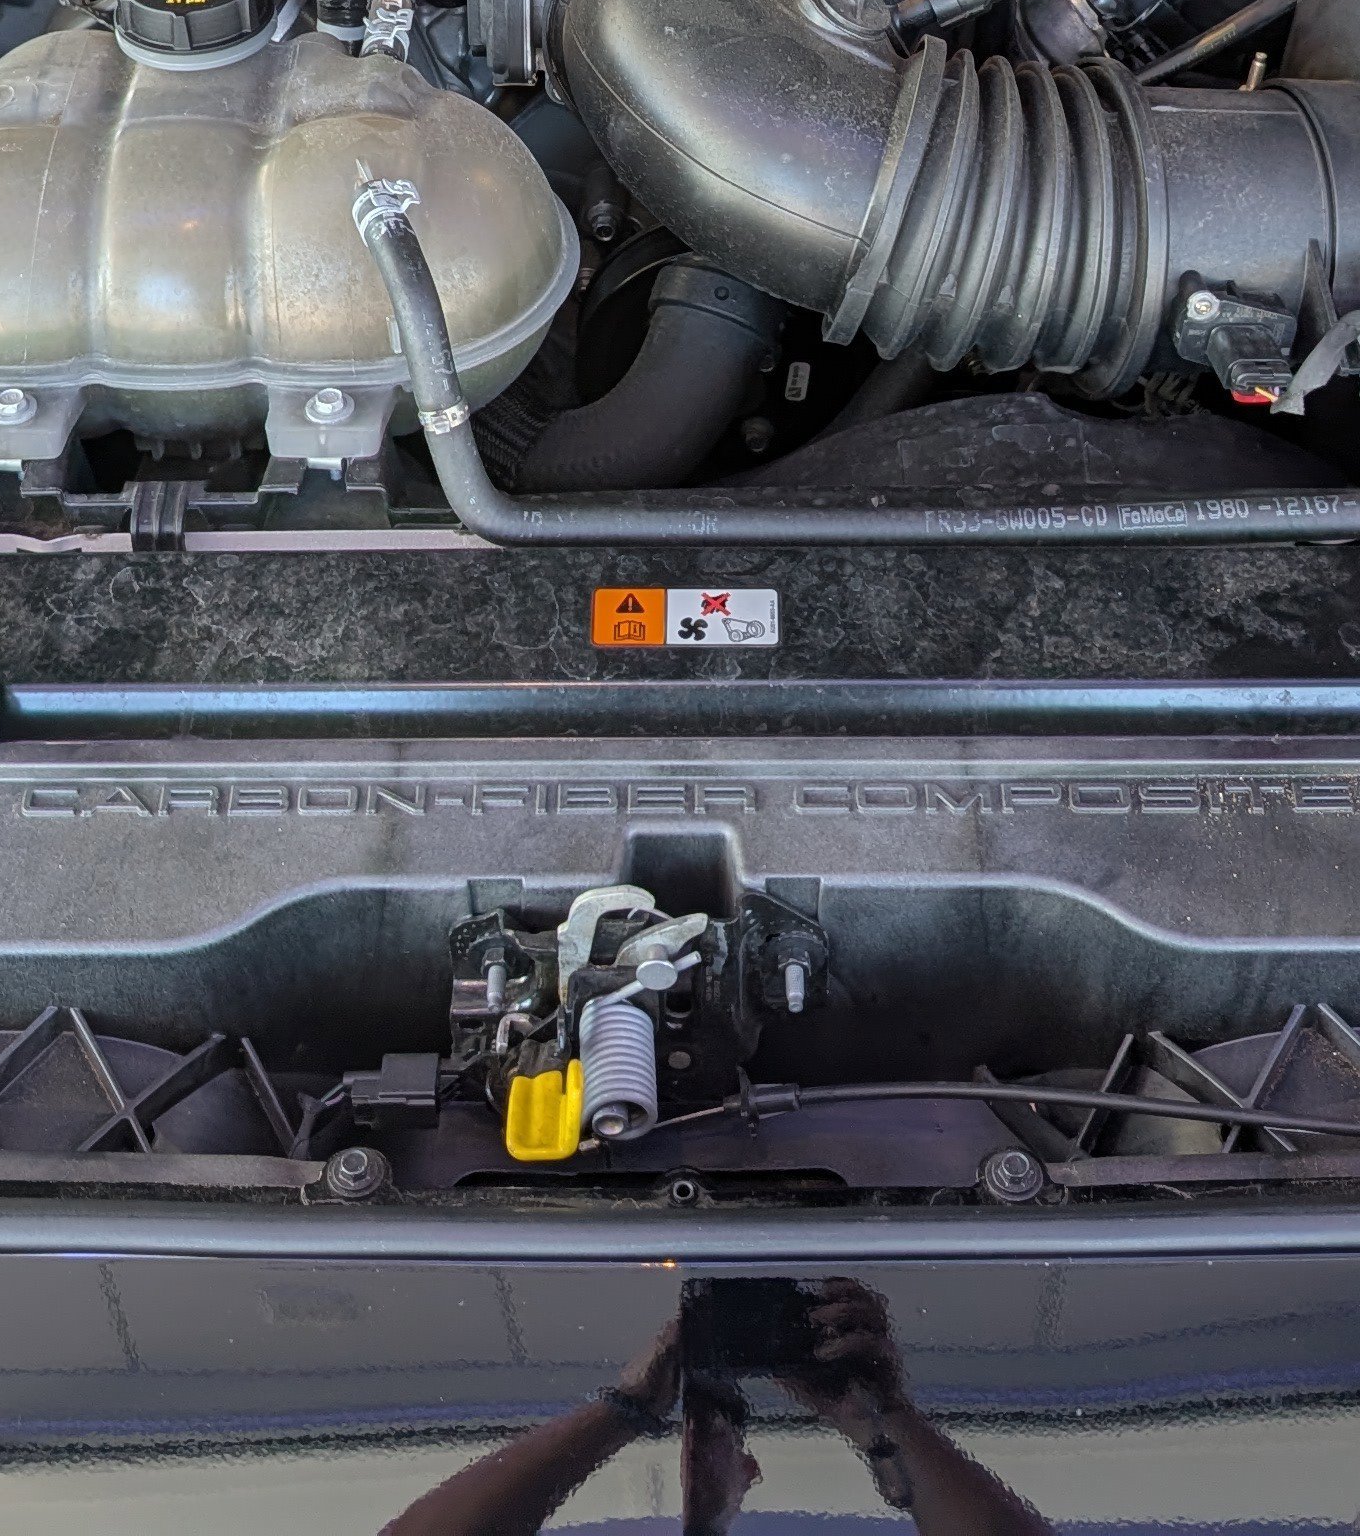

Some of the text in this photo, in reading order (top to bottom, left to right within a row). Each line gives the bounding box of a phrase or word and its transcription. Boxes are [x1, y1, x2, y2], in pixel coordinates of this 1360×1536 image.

[1119, 503, 1187, 528] FoMoCo
[1193, 498, 1250, 521] 1980
[19, 781, 1358, 819] CARBON-FIBER COMPOSITE
